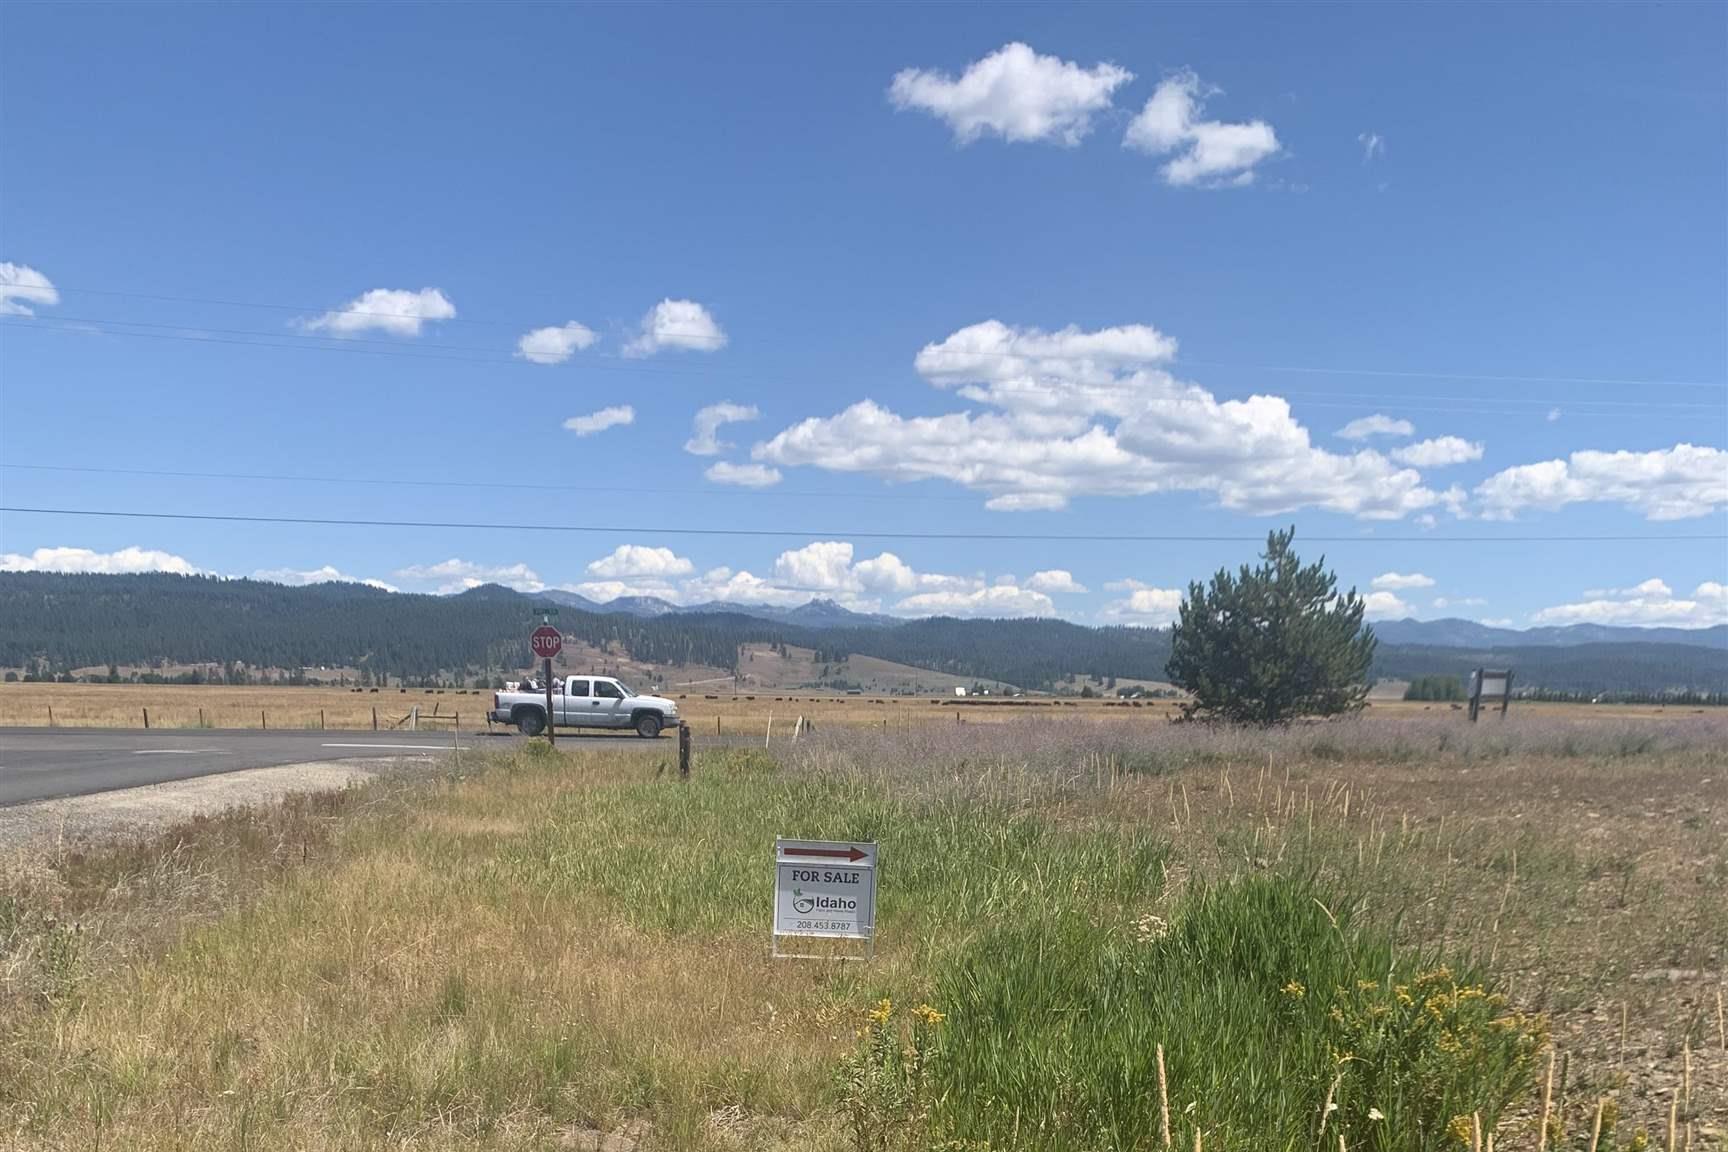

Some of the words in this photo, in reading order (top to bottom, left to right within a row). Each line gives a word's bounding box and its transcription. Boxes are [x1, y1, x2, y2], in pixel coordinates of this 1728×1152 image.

[532, 635, 560, 649] STOP
[792, 870, 820, 882] FOR
[824, 871, 860, 884] SALE
[816, 896, 857, 909] Idaho
[796, 920, 851, 931] 208.453.8787
